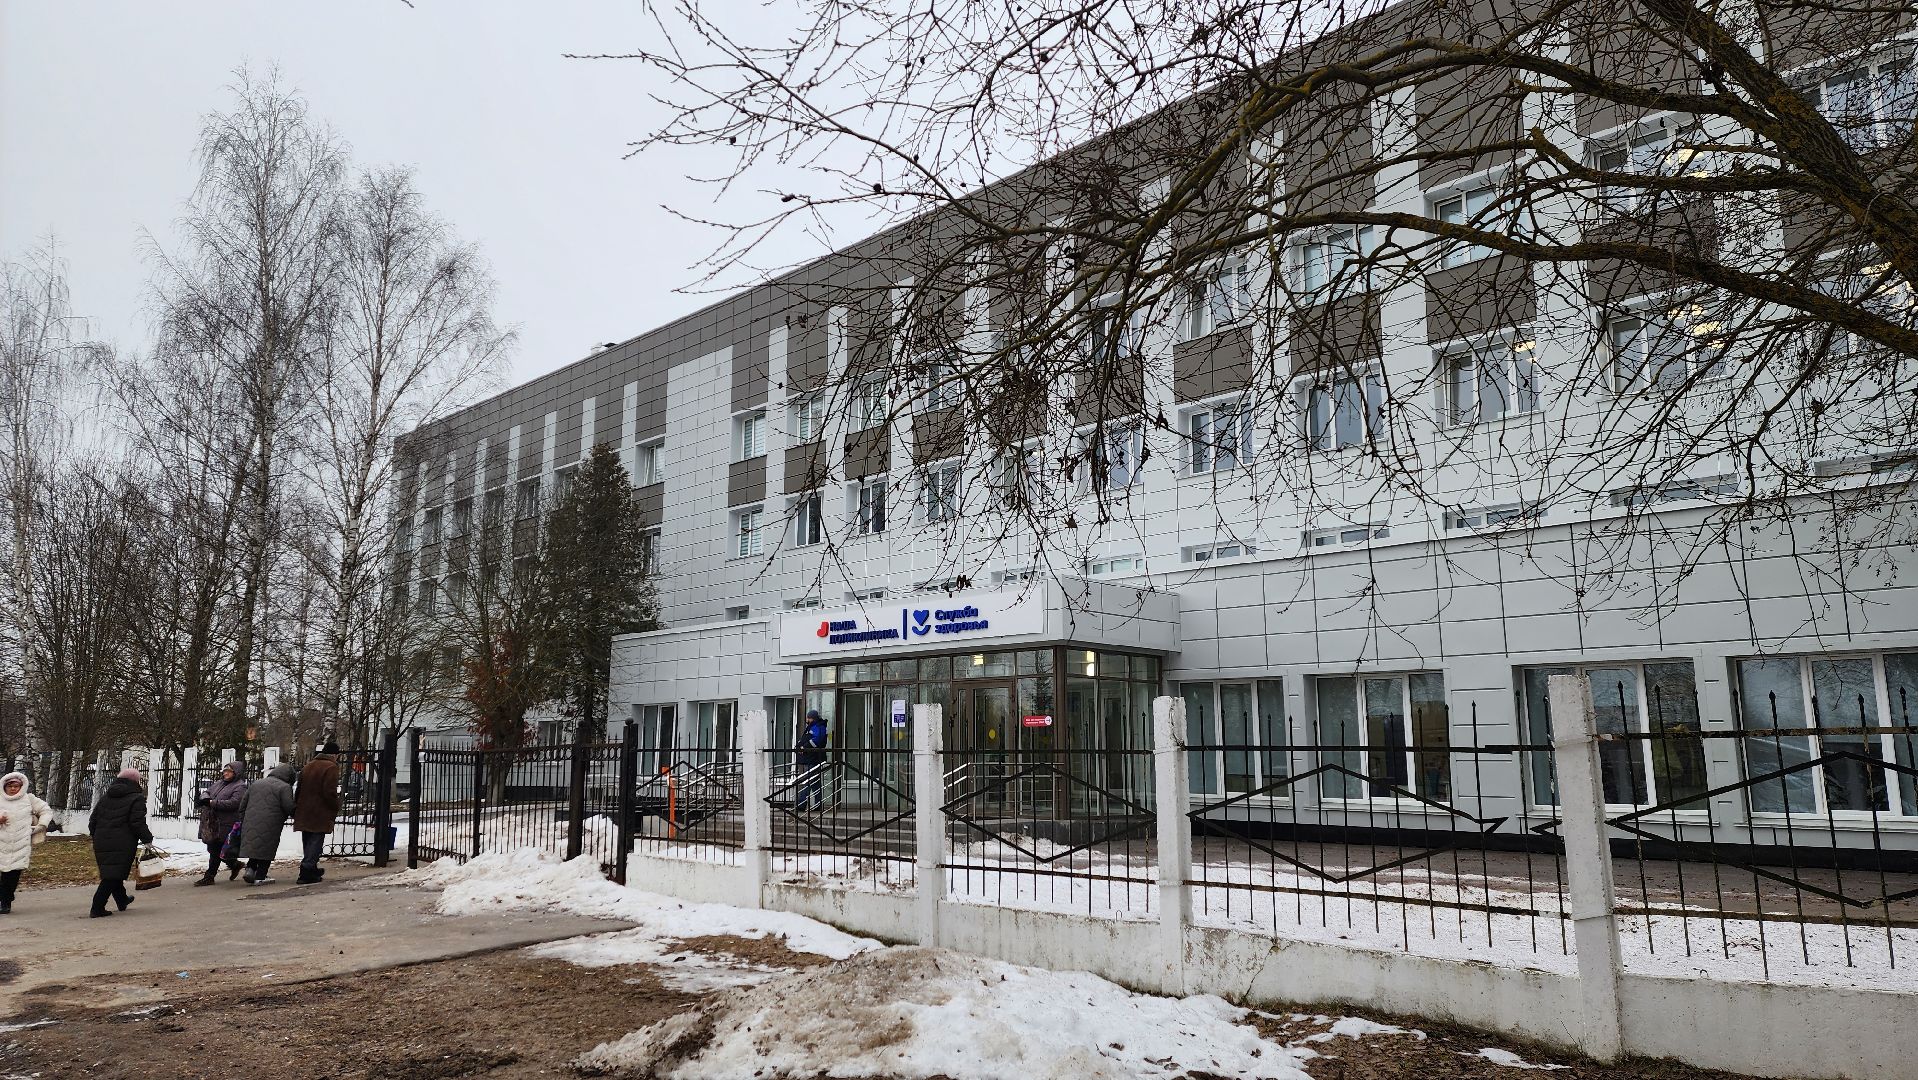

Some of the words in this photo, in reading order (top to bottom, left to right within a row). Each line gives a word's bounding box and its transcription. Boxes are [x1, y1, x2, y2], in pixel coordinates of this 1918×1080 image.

[935, 605, 979, 622] Служба
[830, 620, 857, 632] НАША
[935, 620, 989, 634] здоровья
[829, 628, 899, 644] ПОЛИКЛИНИКА
